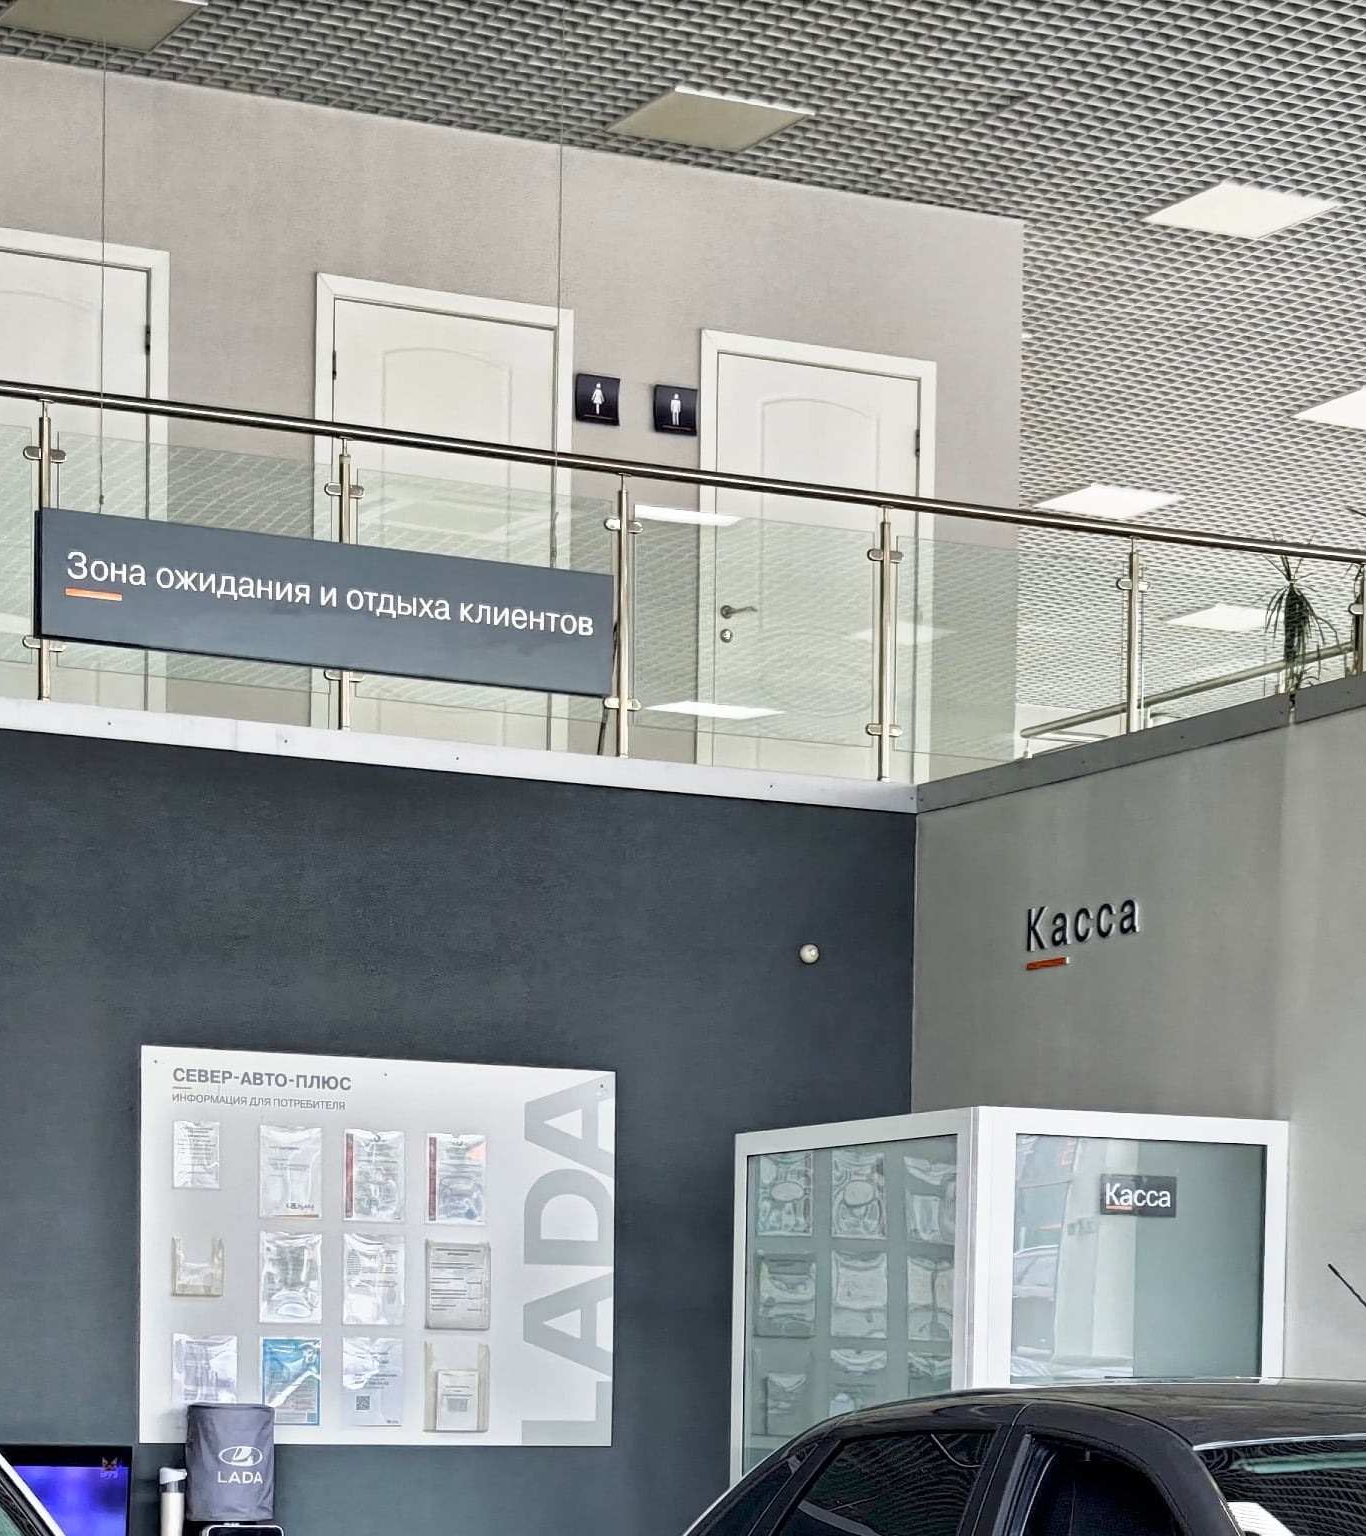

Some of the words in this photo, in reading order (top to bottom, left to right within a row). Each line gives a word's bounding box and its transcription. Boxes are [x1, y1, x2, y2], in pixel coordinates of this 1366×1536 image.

[66, 551, 147, 586] Зона
[156, 567, 310, 605] ожидания
[319, 587, 337, 607] и
[346, 588, 451, 621] отдыха
[459, 603, 594, 636] клиентов
[1026, 899, 1140, 952] Касса
[172, 1067, 352, 1091] СЕВЕР-АВТО-ПЛЮС
[172, 1093, 247, 1105] ИНФОРМАЦИЯ
[249, 1097, 271, 1107] ДЛЯ
[273, 1098, 346, 1111] ПОТРЕБИТЕЛЯ
[1105, 1182, 1171, 1207] Касса
[521, 1073, 615, 1446] LADA
[217, 1471, 264, 1484] LADA
